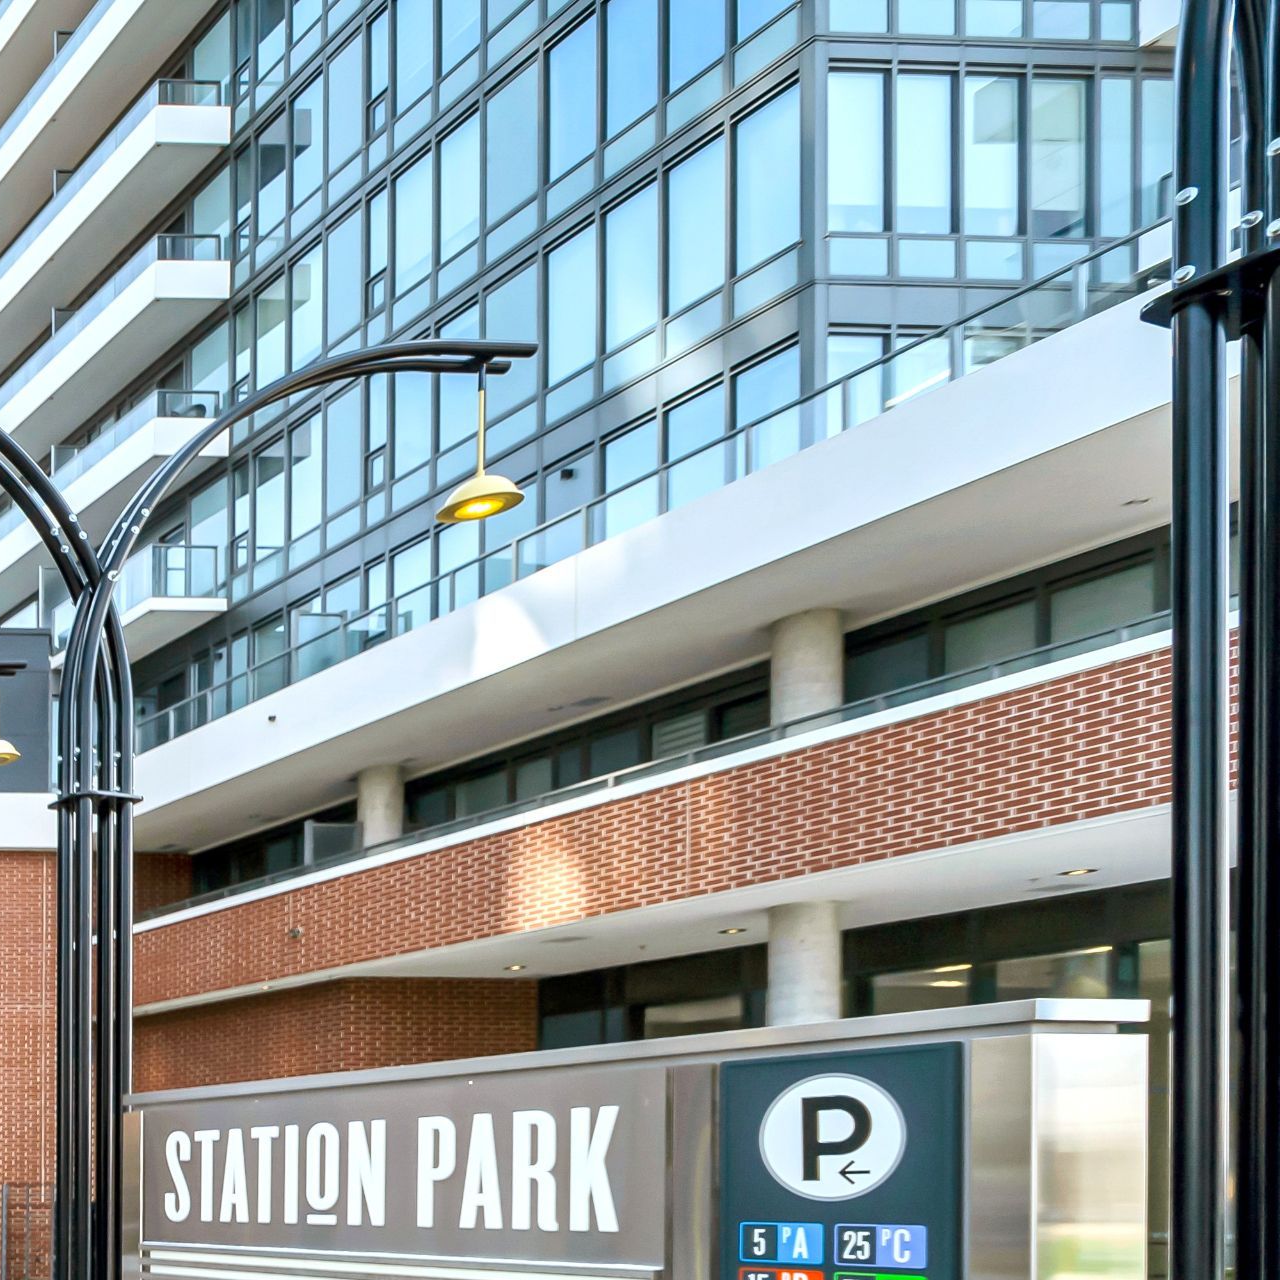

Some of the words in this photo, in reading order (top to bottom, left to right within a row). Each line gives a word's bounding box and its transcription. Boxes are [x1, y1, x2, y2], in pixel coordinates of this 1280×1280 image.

[801, 1095, 872, 1181] P
[164, 1119, 386, 1227] STATION
[416, 1105, 620, 1232] PARK
[753, 1228, 766, 1256] 5
[842, 1230, 871, 1260] 25
